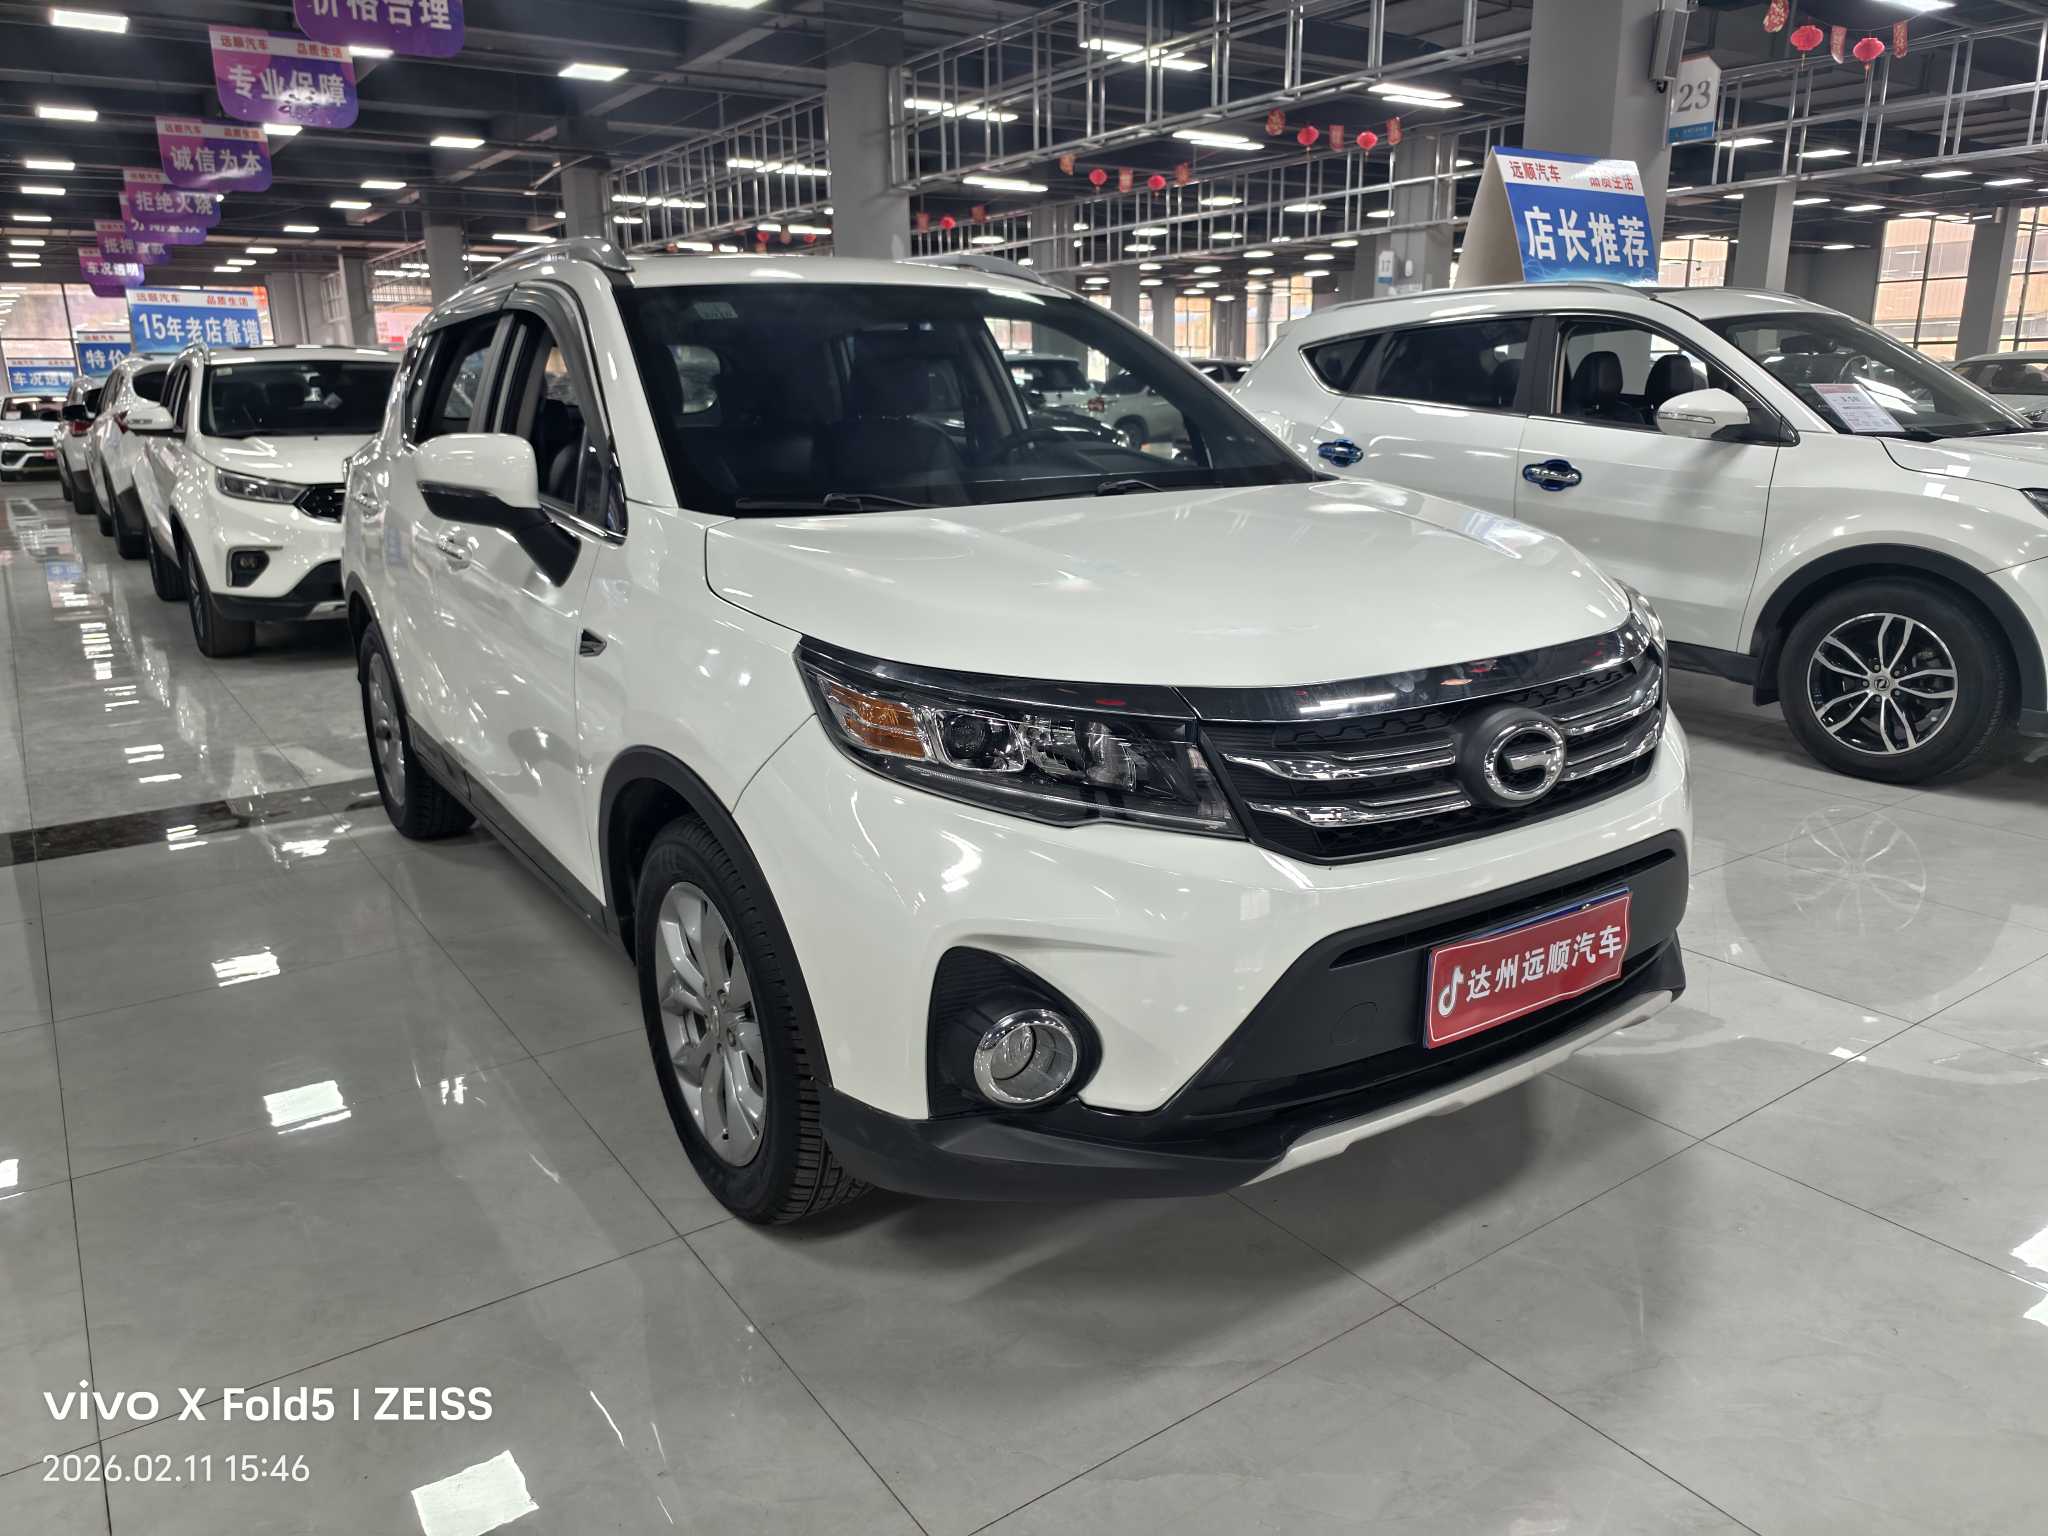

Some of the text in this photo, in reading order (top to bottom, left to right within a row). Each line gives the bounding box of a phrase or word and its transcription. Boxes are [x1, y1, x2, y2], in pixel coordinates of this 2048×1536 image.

[228, 64, 347, 107] 专业保障
[1676, 80, 1711, 112] 23
[170, 145, 263, 175] 诚信为本
[1508, 160, 1561, 183] 远顺汽车
[1589, 175, 1634, 191] 品质生活
[1523, 205, 1649, 268] 店长推荐
[138, 312, 260, 345] 15年老店靠谱
[1465, 925, 1622, 1001] 达州远顺汽车
